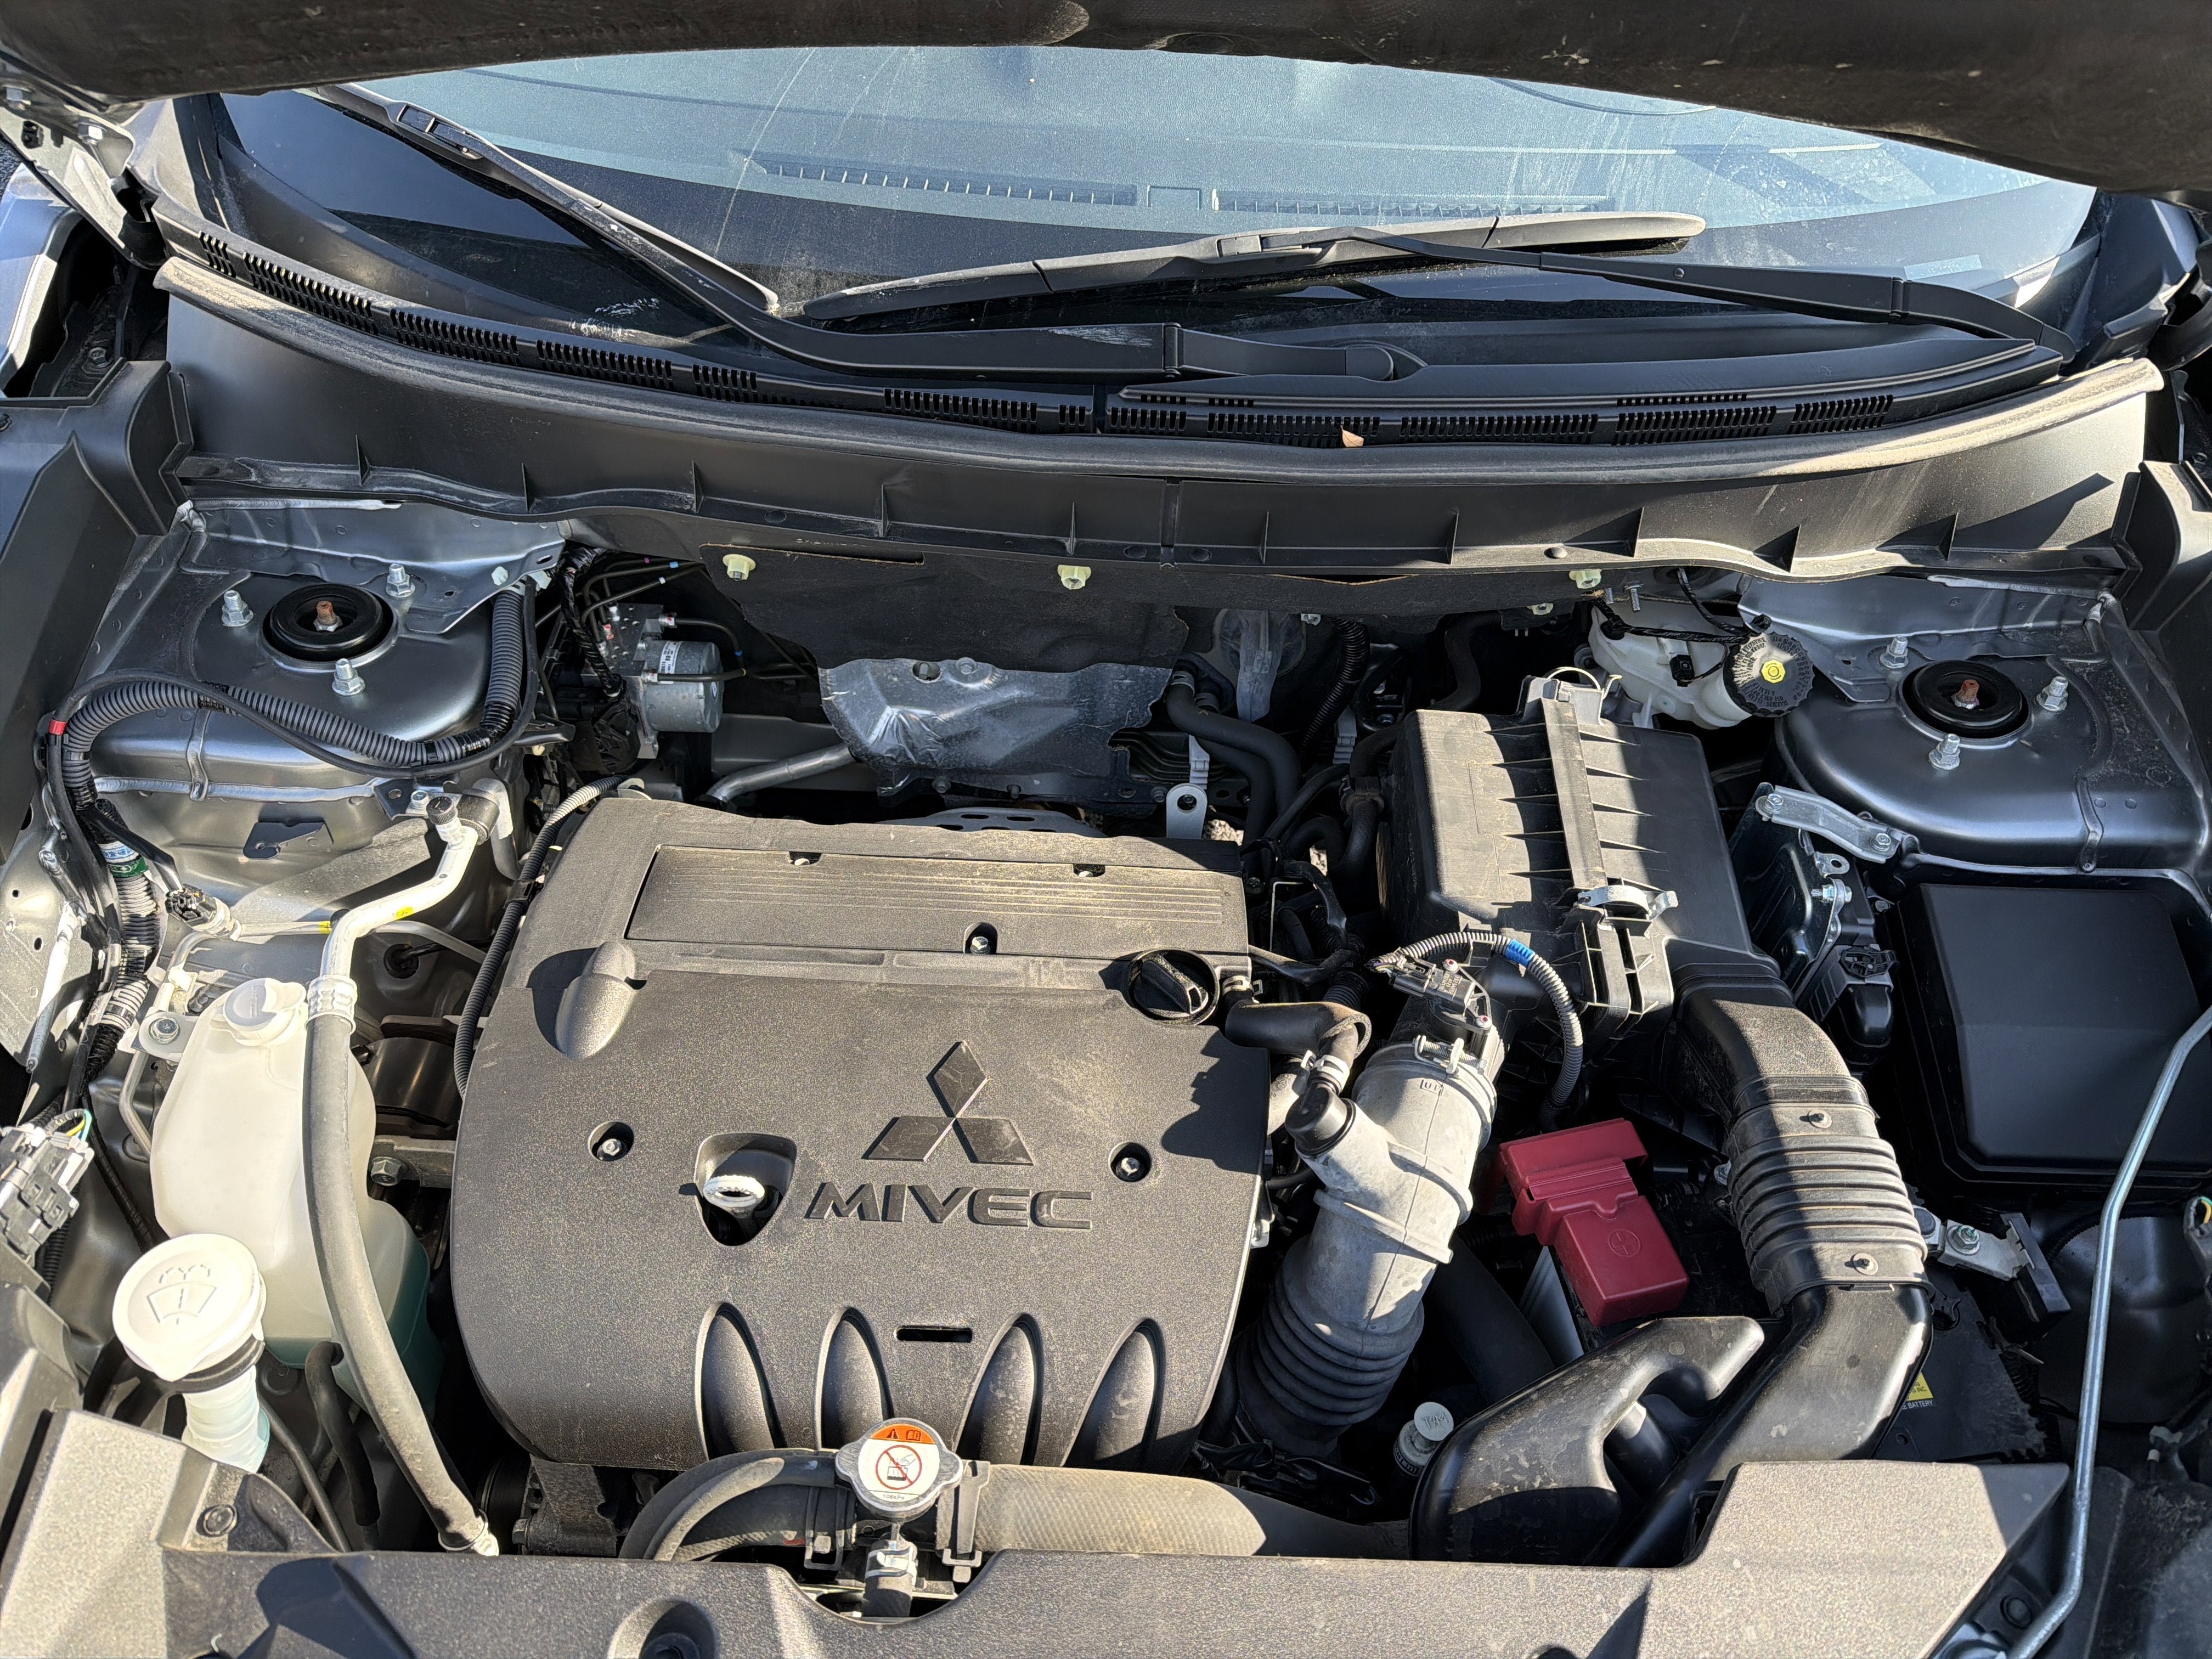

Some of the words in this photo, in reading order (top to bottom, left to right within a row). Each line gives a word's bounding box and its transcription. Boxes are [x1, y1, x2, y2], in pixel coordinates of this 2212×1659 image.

[804, 1182, 1092, 1229] MIVEC
[1908, 1400, 1933, 1409] BATTERY
[1421, 1412, 1449, 1429] T/M
